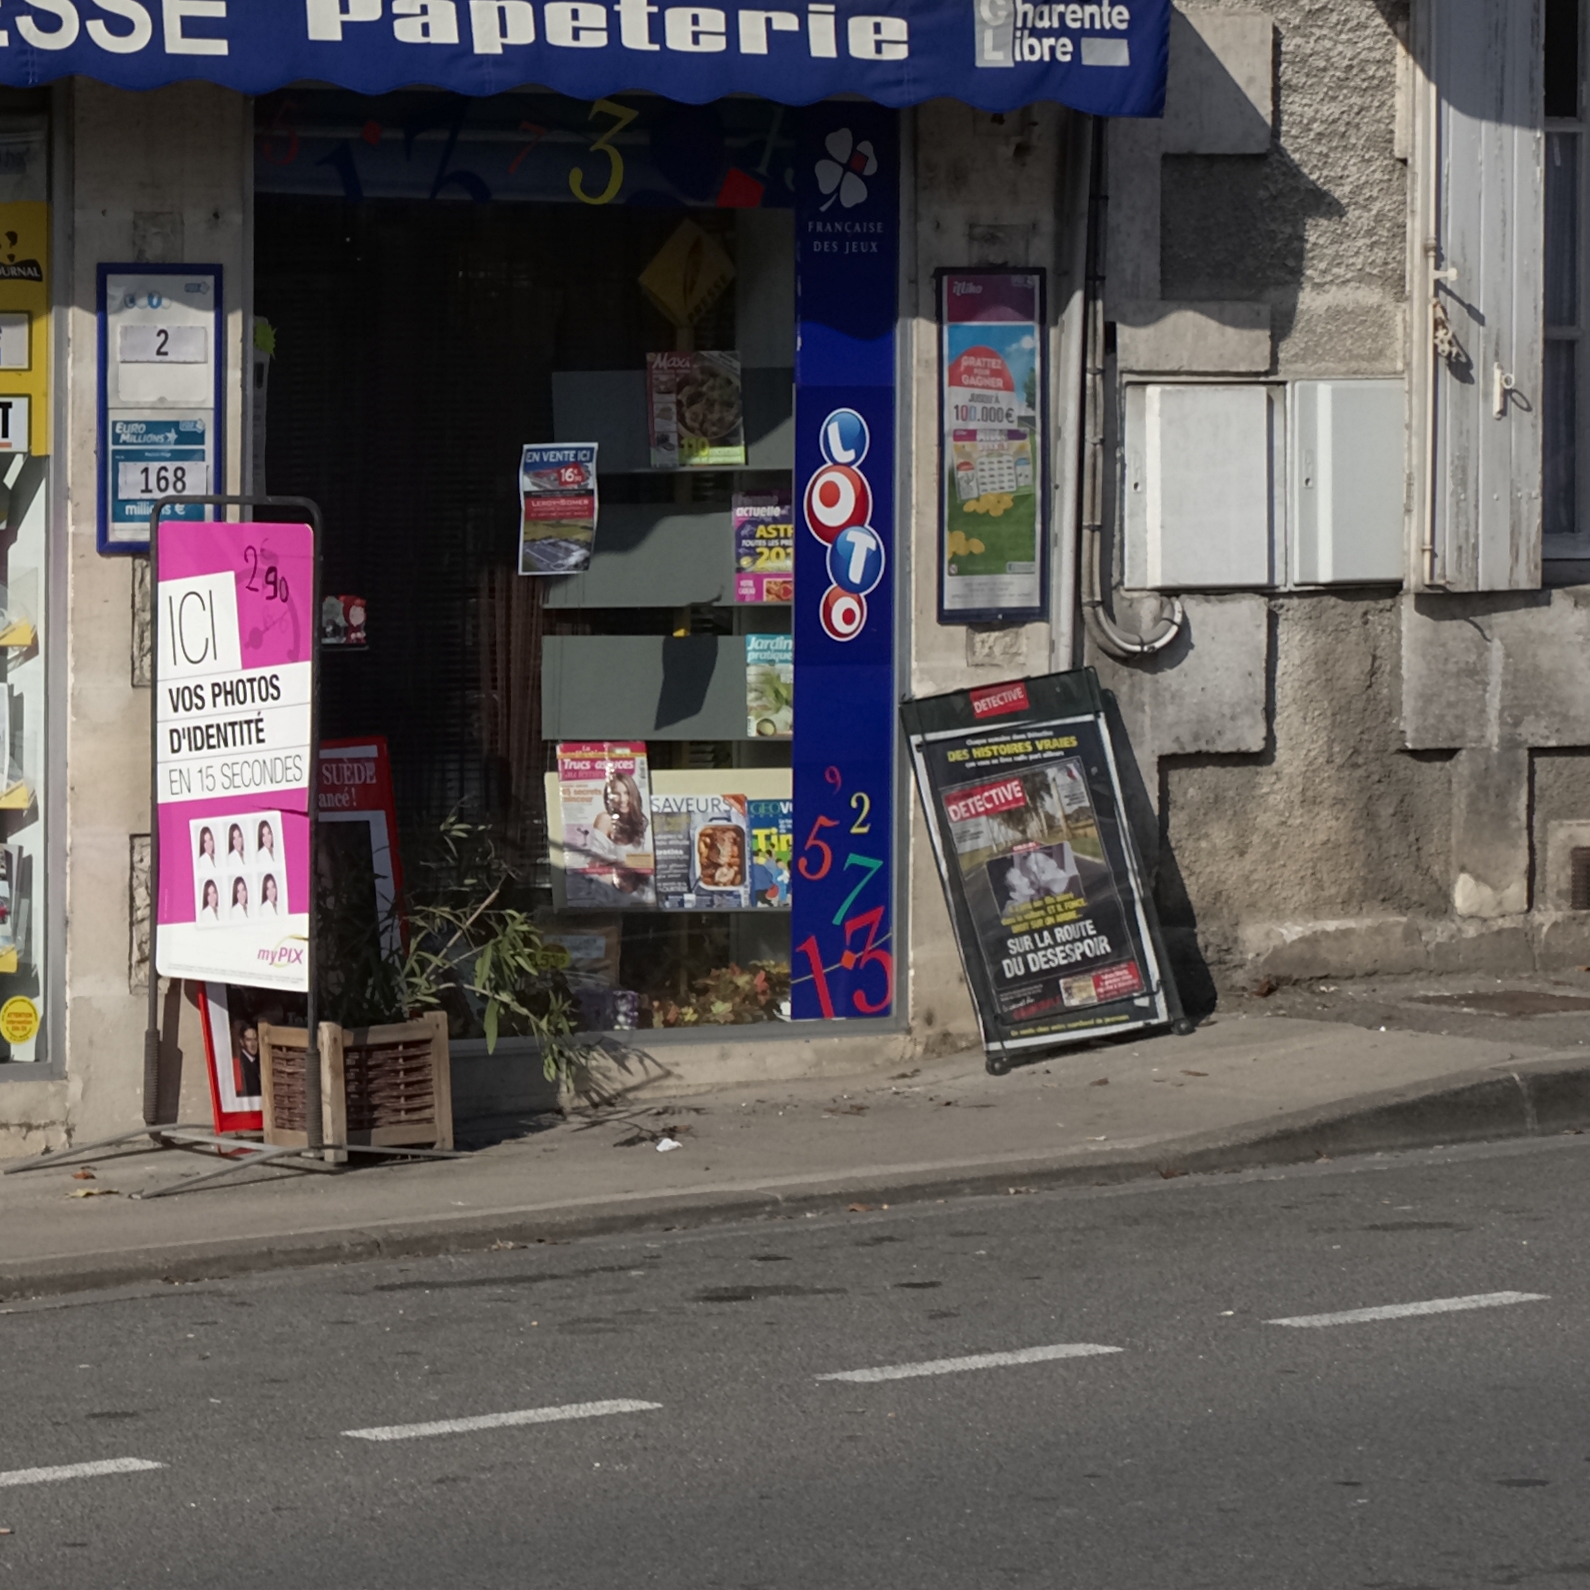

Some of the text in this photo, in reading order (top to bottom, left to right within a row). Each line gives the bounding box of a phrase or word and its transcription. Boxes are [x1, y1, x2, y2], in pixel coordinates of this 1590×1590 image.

[814, 240, 879, 254] DES JEUX
[156, 329, 169, 356] 2
[115, 422, 146, 434] EURO
[526, 450, 591, 462] EN VENTE ICI
[140, 466, 186, 493] 168
[804, 409, 884, 641] LOTO
[169, 590, 217, 666] ICI
[168, 674, 281, 713] VOS PHOTOS
[170, 711, 266, 754] D'IDENTITÉ
[947, 736, 1078, 762] DES HISTOIRES VRAIES
[169, 754, 303, 795] EN 15 SECONDES
[948, 780, 1023, 822] DETECTIVE
[798, 816, 840, 880] 5
[832, 853, 883, 926] 7
[1002, 935, 1112, 979] DU DESESPOIR
[1007, 919, 1097, 955] SUR LA ROUTE
